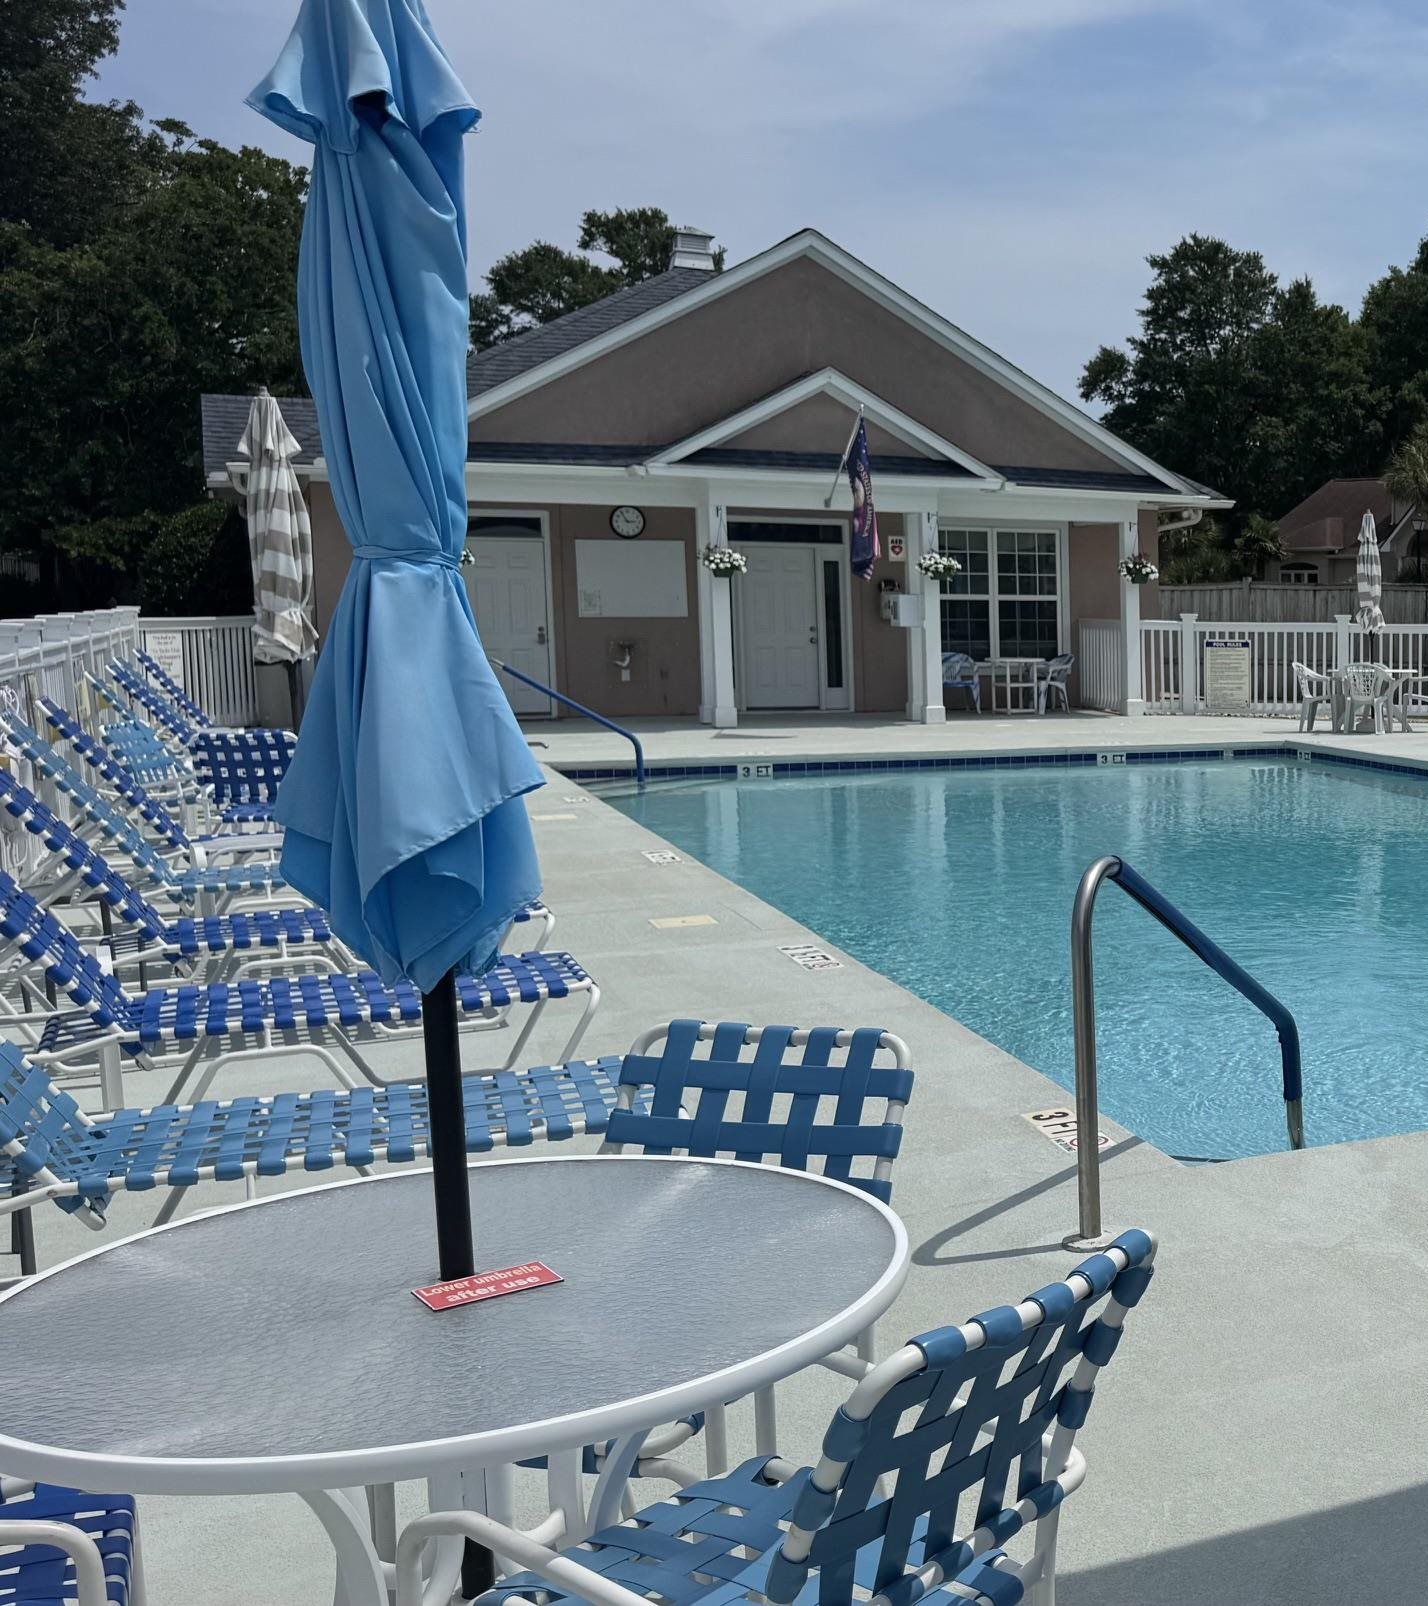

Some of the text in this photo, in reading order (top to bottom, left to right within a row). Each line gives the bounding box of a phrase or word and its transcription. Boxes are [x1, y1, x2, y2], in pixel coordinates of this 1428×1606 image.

[1100, 754, 1108, 765] 3
[742, 766, 751, 778] 3
[1032, 1111, 1069, 1121] 3
[419, 1265, 543, 1298] Lower umbrella
[446, 1276, 541, 1302] after use
